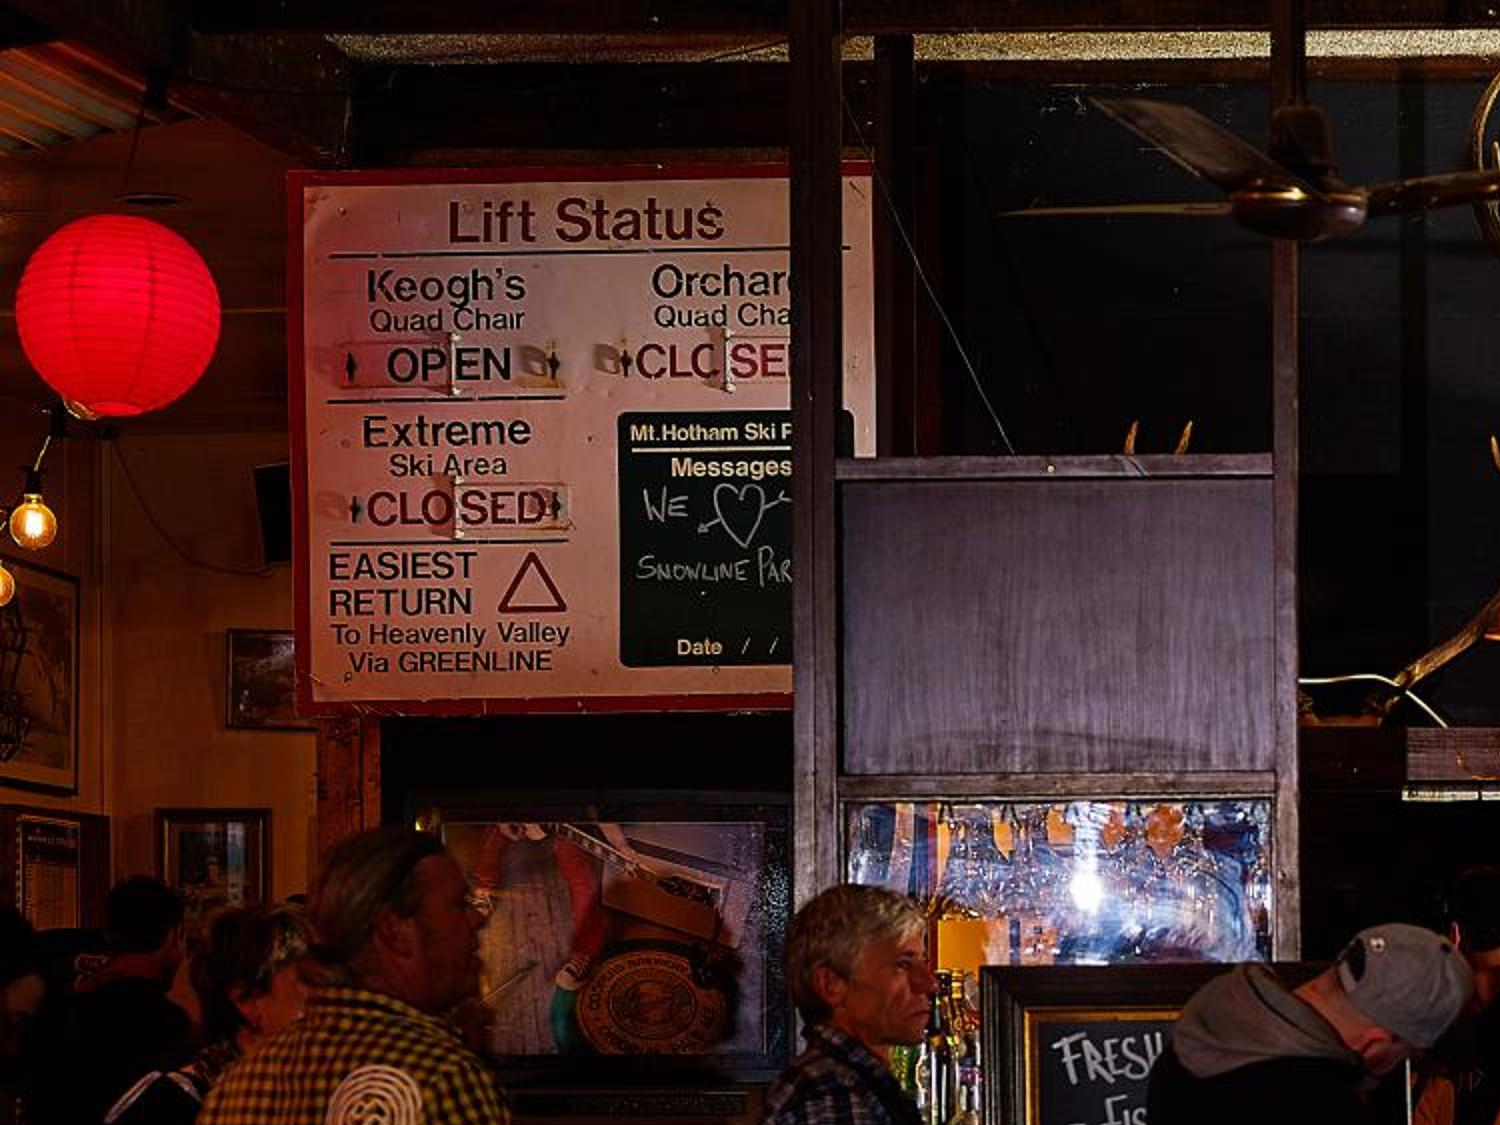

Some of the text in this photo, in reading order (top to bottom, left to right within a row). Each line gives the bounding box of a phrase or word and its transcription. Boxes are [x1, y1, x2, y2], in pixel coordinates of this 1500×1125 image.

[450, 197, 724, 243] Lift Status
[367, 267, 526, 307] Keogh's
[652, 263, 790, 298] Orchar
[370, 307, 526, 332] Quad Chair
[654, 302, 791, 327] Quad Cha
[387, 347, 511, 383] OPEN
[636, 343, 791, 379] CLOSE
[363, 415, 531, 448] Extreme
[744, 423, 776, 440] Ski
[389, 454, 508, 477] Ski Area
[671, 457, 792, 481] Messages
[367, 490, 546, 526] CLOSED
[643, 485, 689, 523] WE
[329, 551, 477, 580] EASIEST
[758, 546, 793, 588] PAR
[329, 588, 472, 617] RETURN
[331, 622, 570, 648] To Heavenly Valley
[677, 638, 722, 655] Date
[349, 650, 553, 674] Via GREENLINE
